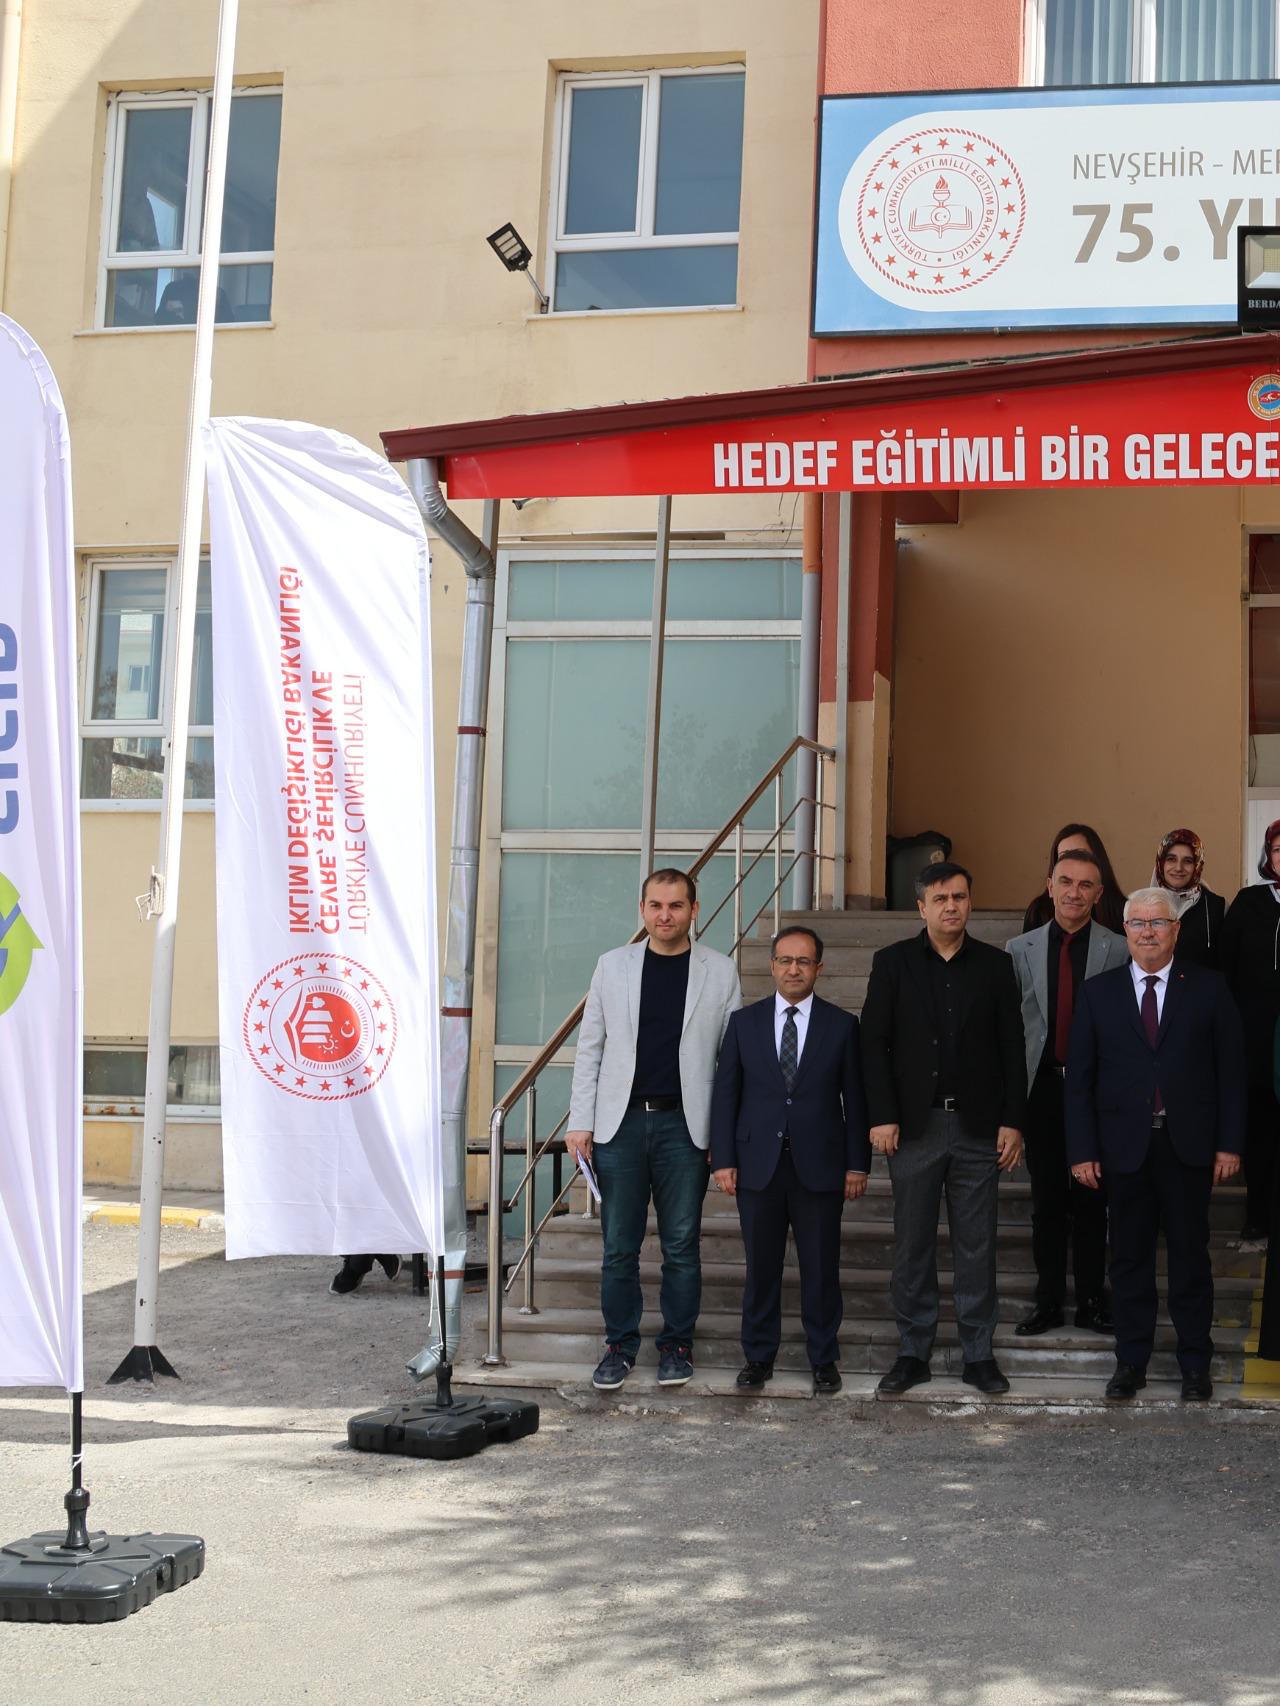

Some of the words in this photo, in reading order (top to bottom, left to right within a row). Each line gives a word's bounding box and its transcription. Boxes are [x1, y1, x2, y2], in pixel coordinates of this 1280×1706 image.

[970, 169, 995, 205] EĞİTİM
[1073, 146, 1205, 185] NEVŞEHİR
[888, 159, 935, 224] CUMHURİYETİ
[891, 226, 928, 262] TÜRKİYE
[952, 209, 995, 260] BAKANLIĞI
[1072, 202, 1181, 263] 75.
[713, 441, 839, 487] HEDEF
[852, 425, 1026, 485] EĞİTİMLİ
[1041, 425, 1109, 480] BİR
